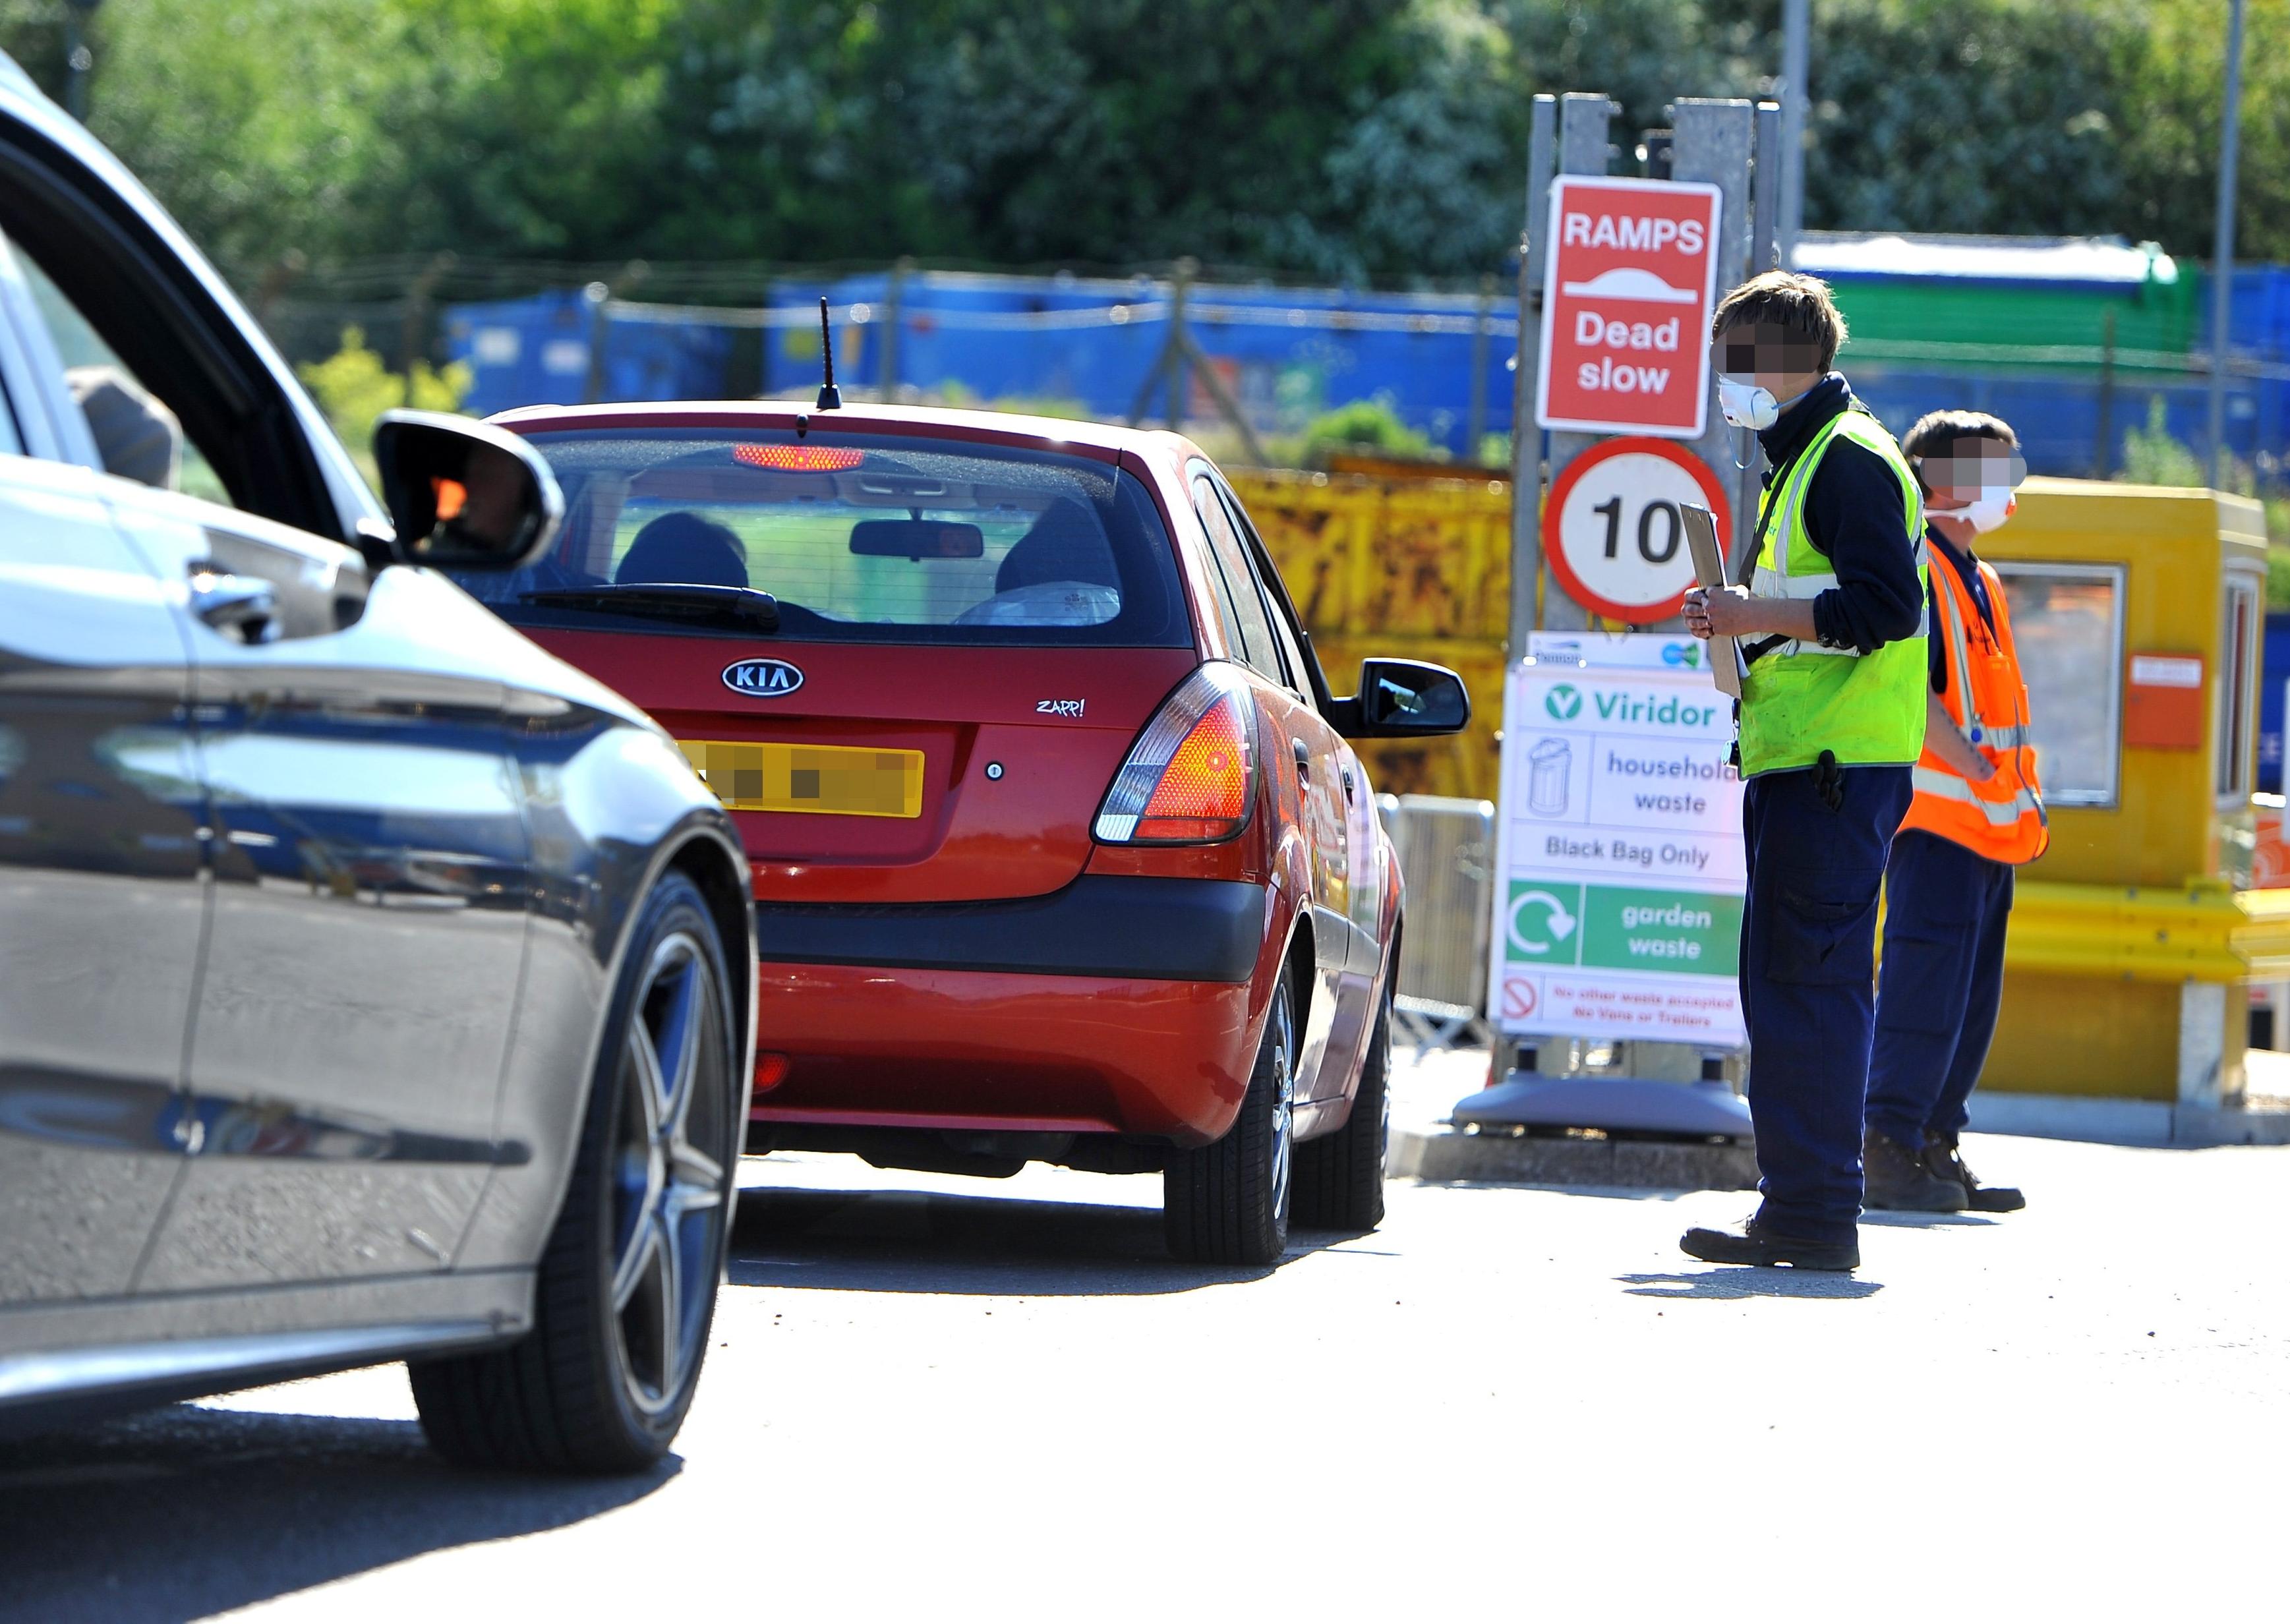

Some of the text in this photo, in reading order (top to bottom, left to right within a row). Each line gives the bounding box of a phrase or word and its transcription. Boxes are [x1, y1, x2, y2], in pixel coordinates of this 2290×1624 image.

[1564, 212, 1705, 255] RAMPS
[1575, 310, 1680, 352] Dead
[1578, 357, 1670, 395] slow
[1593, 495, 1682, 564] 10
[736, 666, 790, 688] KIA
[1036, 699, 1085, 717] ZAPP!
[1595, 690, 1716, 726] Viridor
[1634, 792, 1707, 815] waste
[1546, 836, 1709, 869] Black Bag Only
[1623, 904, 1711, 928] garden
[1629, 937, 1701, 959] waste
[1554, 987, 1734, 1009] No other waste accepted
[1573, 1006, 1711, 1027] No Vans or Trailers
